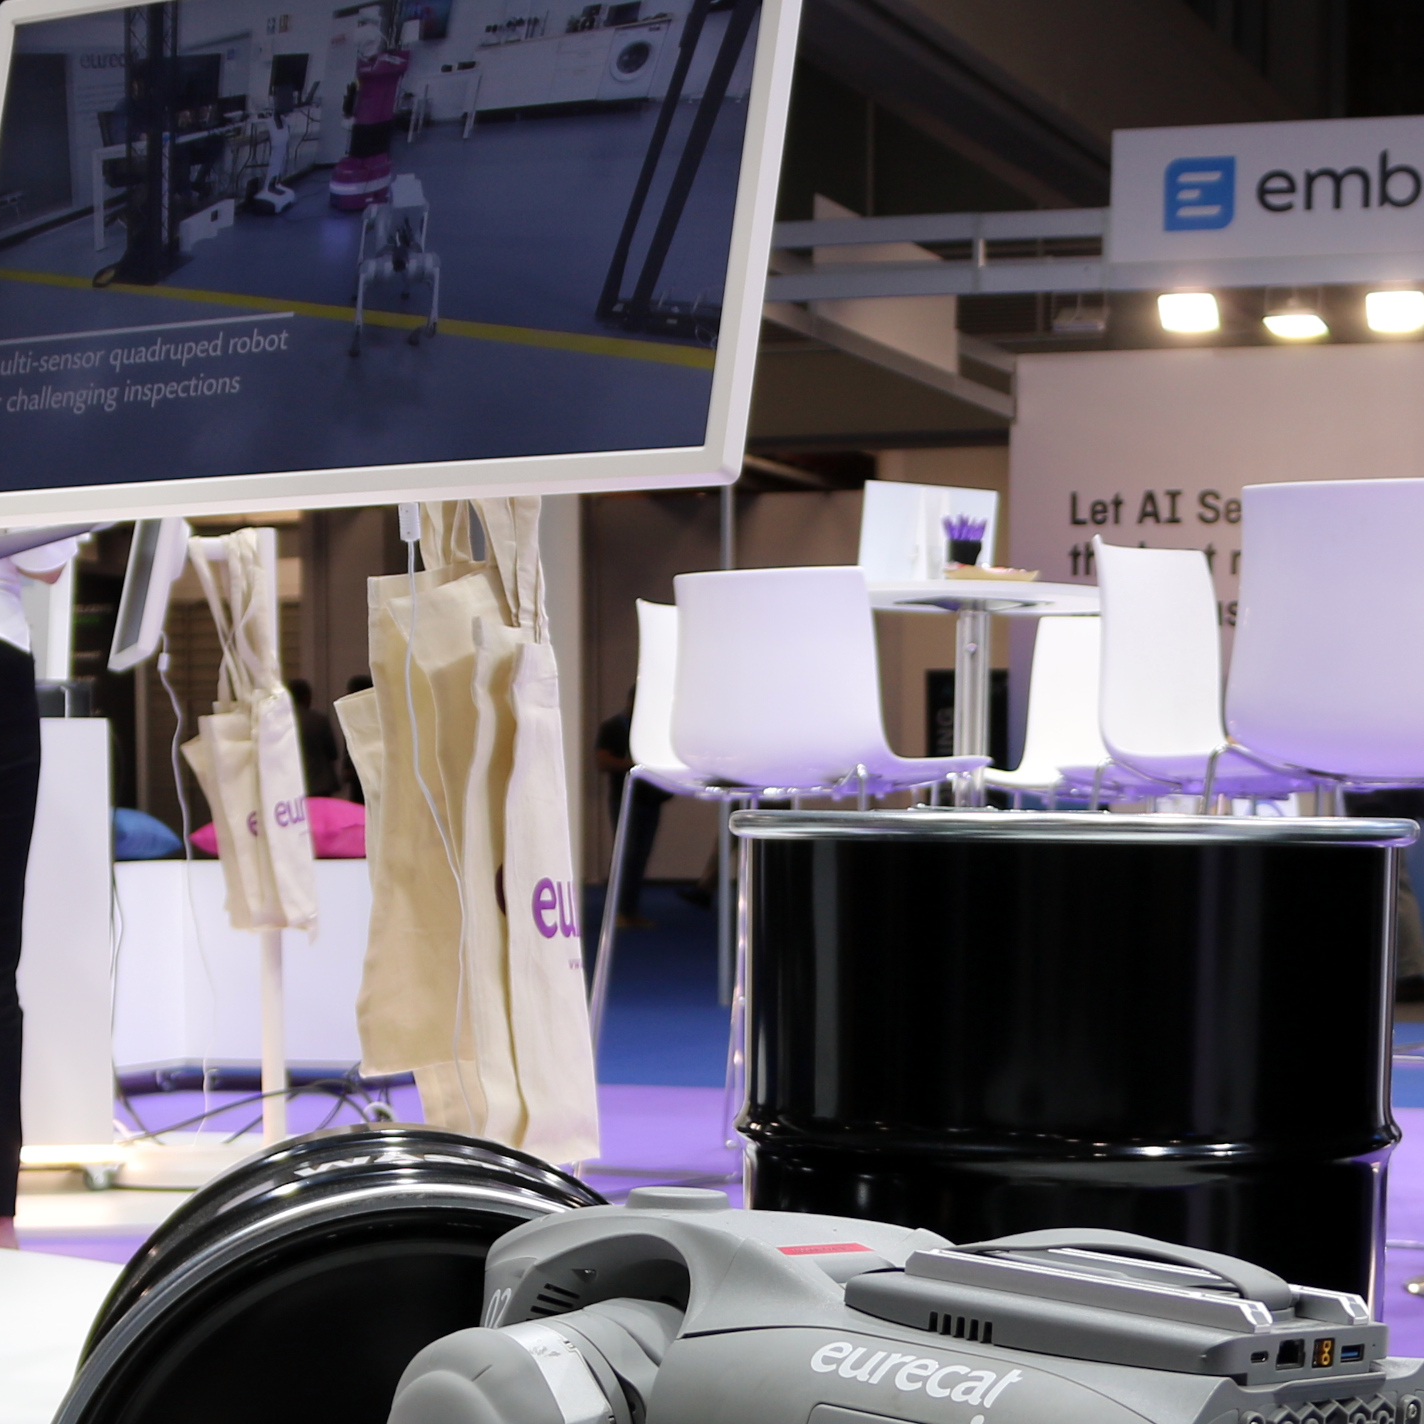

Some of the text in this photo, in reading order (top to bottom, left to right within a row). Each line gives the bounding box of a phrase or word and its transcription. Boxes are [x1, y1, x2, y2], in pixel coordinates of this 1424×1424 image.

[109, 332, 223, 372] quadruped
[229, 329, 289, 353] robot
[7, 385, 118, 413] challenging
[124, 374, 240, 407] inspections
[1070, 491, 1123, 525] Let
[1137, 490, 1182, 524] AI
